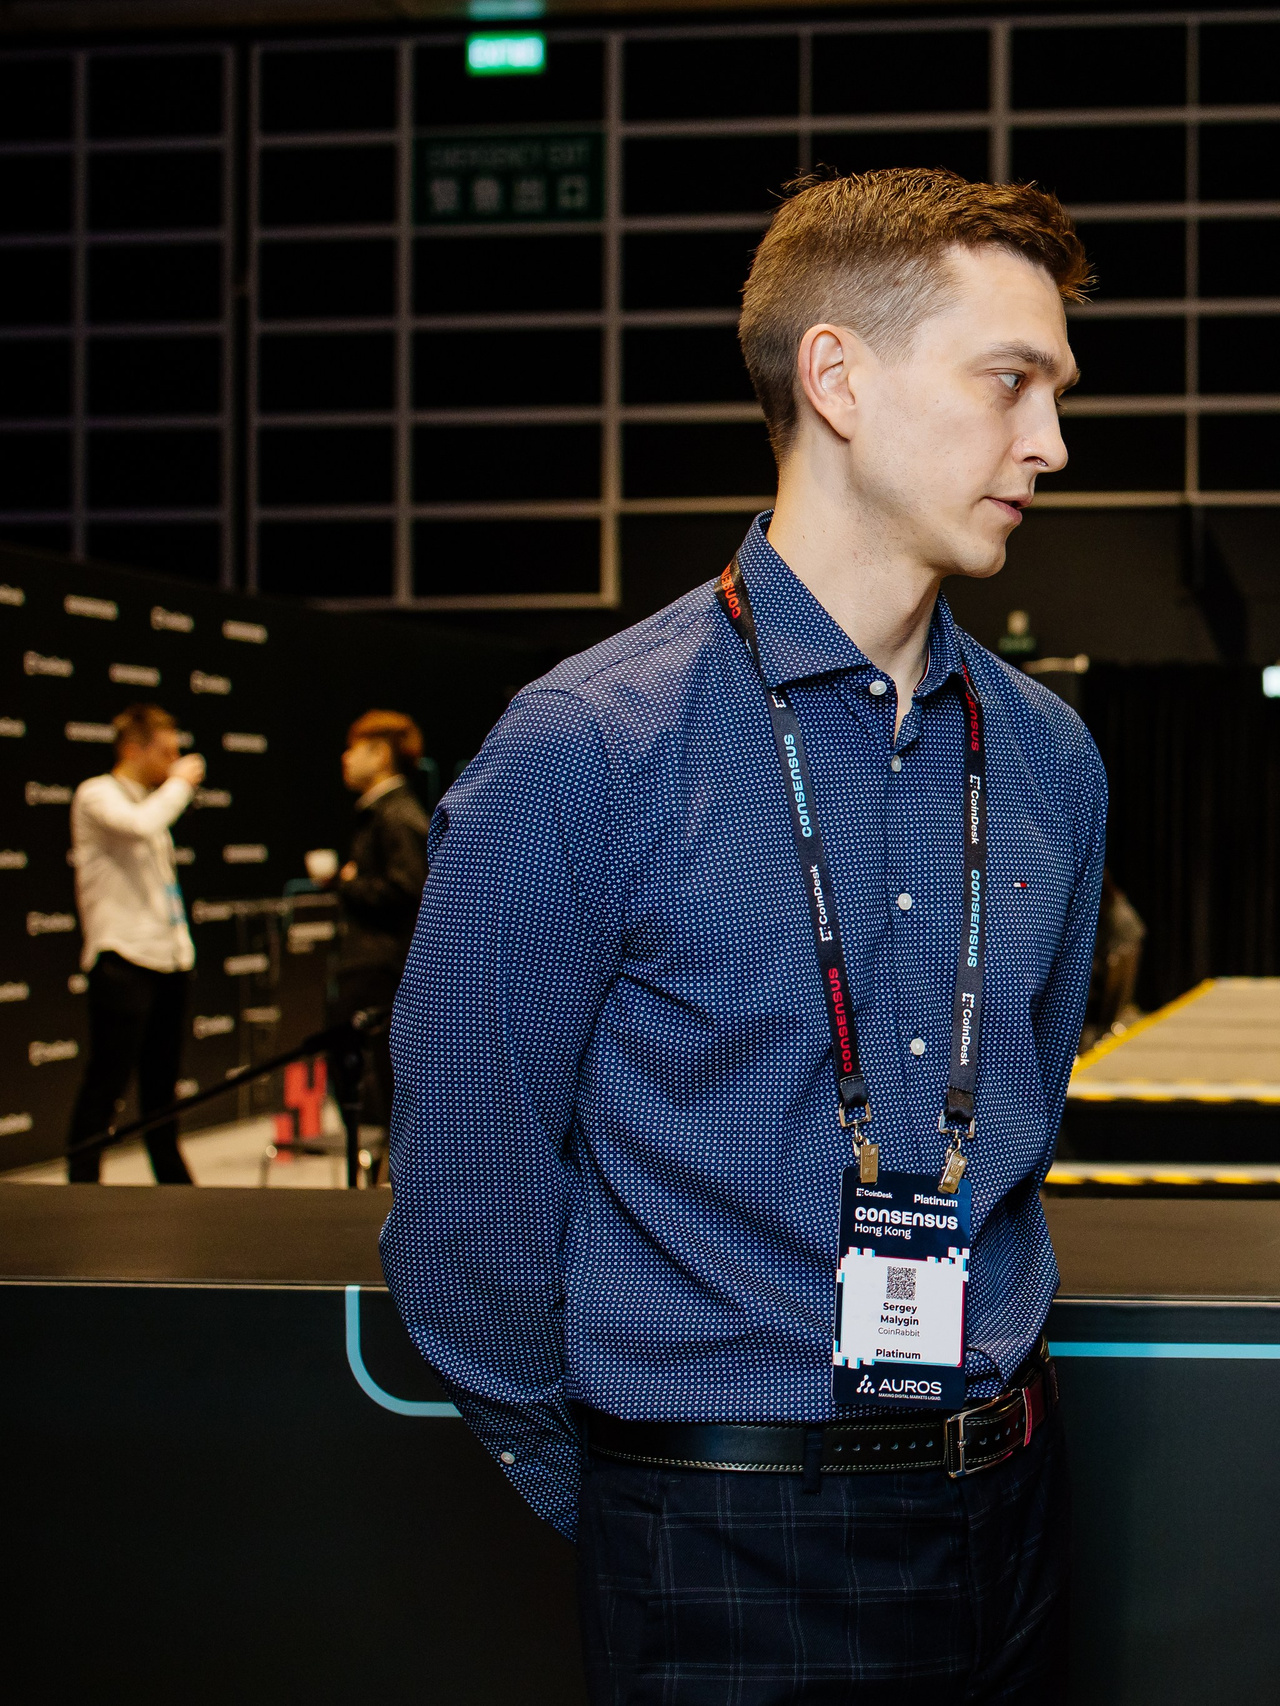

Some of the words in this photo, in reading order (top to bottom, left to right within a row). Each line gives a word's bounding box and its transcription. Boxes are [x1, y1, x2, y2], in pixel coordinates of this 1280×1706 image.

[784, 734, 812, 837] CONSENSUS
[971, 790, 980, 844] CoinDesk
[810, 864, 828, 924] CoinDesk
[967, 869, 980, 967] CONSENSUS
[828, 967, 852, 1073] CONSENSUS
[960, 1008, 972, 1066] CoinDesk
[864, 1189, 893, 1199] CoinDesk
[914, 1194, 958, 1207] Platinum
[855, 1206, 958, 1230] CONSENSUS
[854, 1223, 882, 1237] Hong
[884, 1225, 911, 1240] Kong
[883, 1302, 917, 1314] Sergey
[880, 1315, 919, 1326] Malygin
[878, 1327, 920, 1337] CoinRabbit
[876, 1349, 921, 1360] Platinum
[879, 1378, 942, 1395] AUROS
